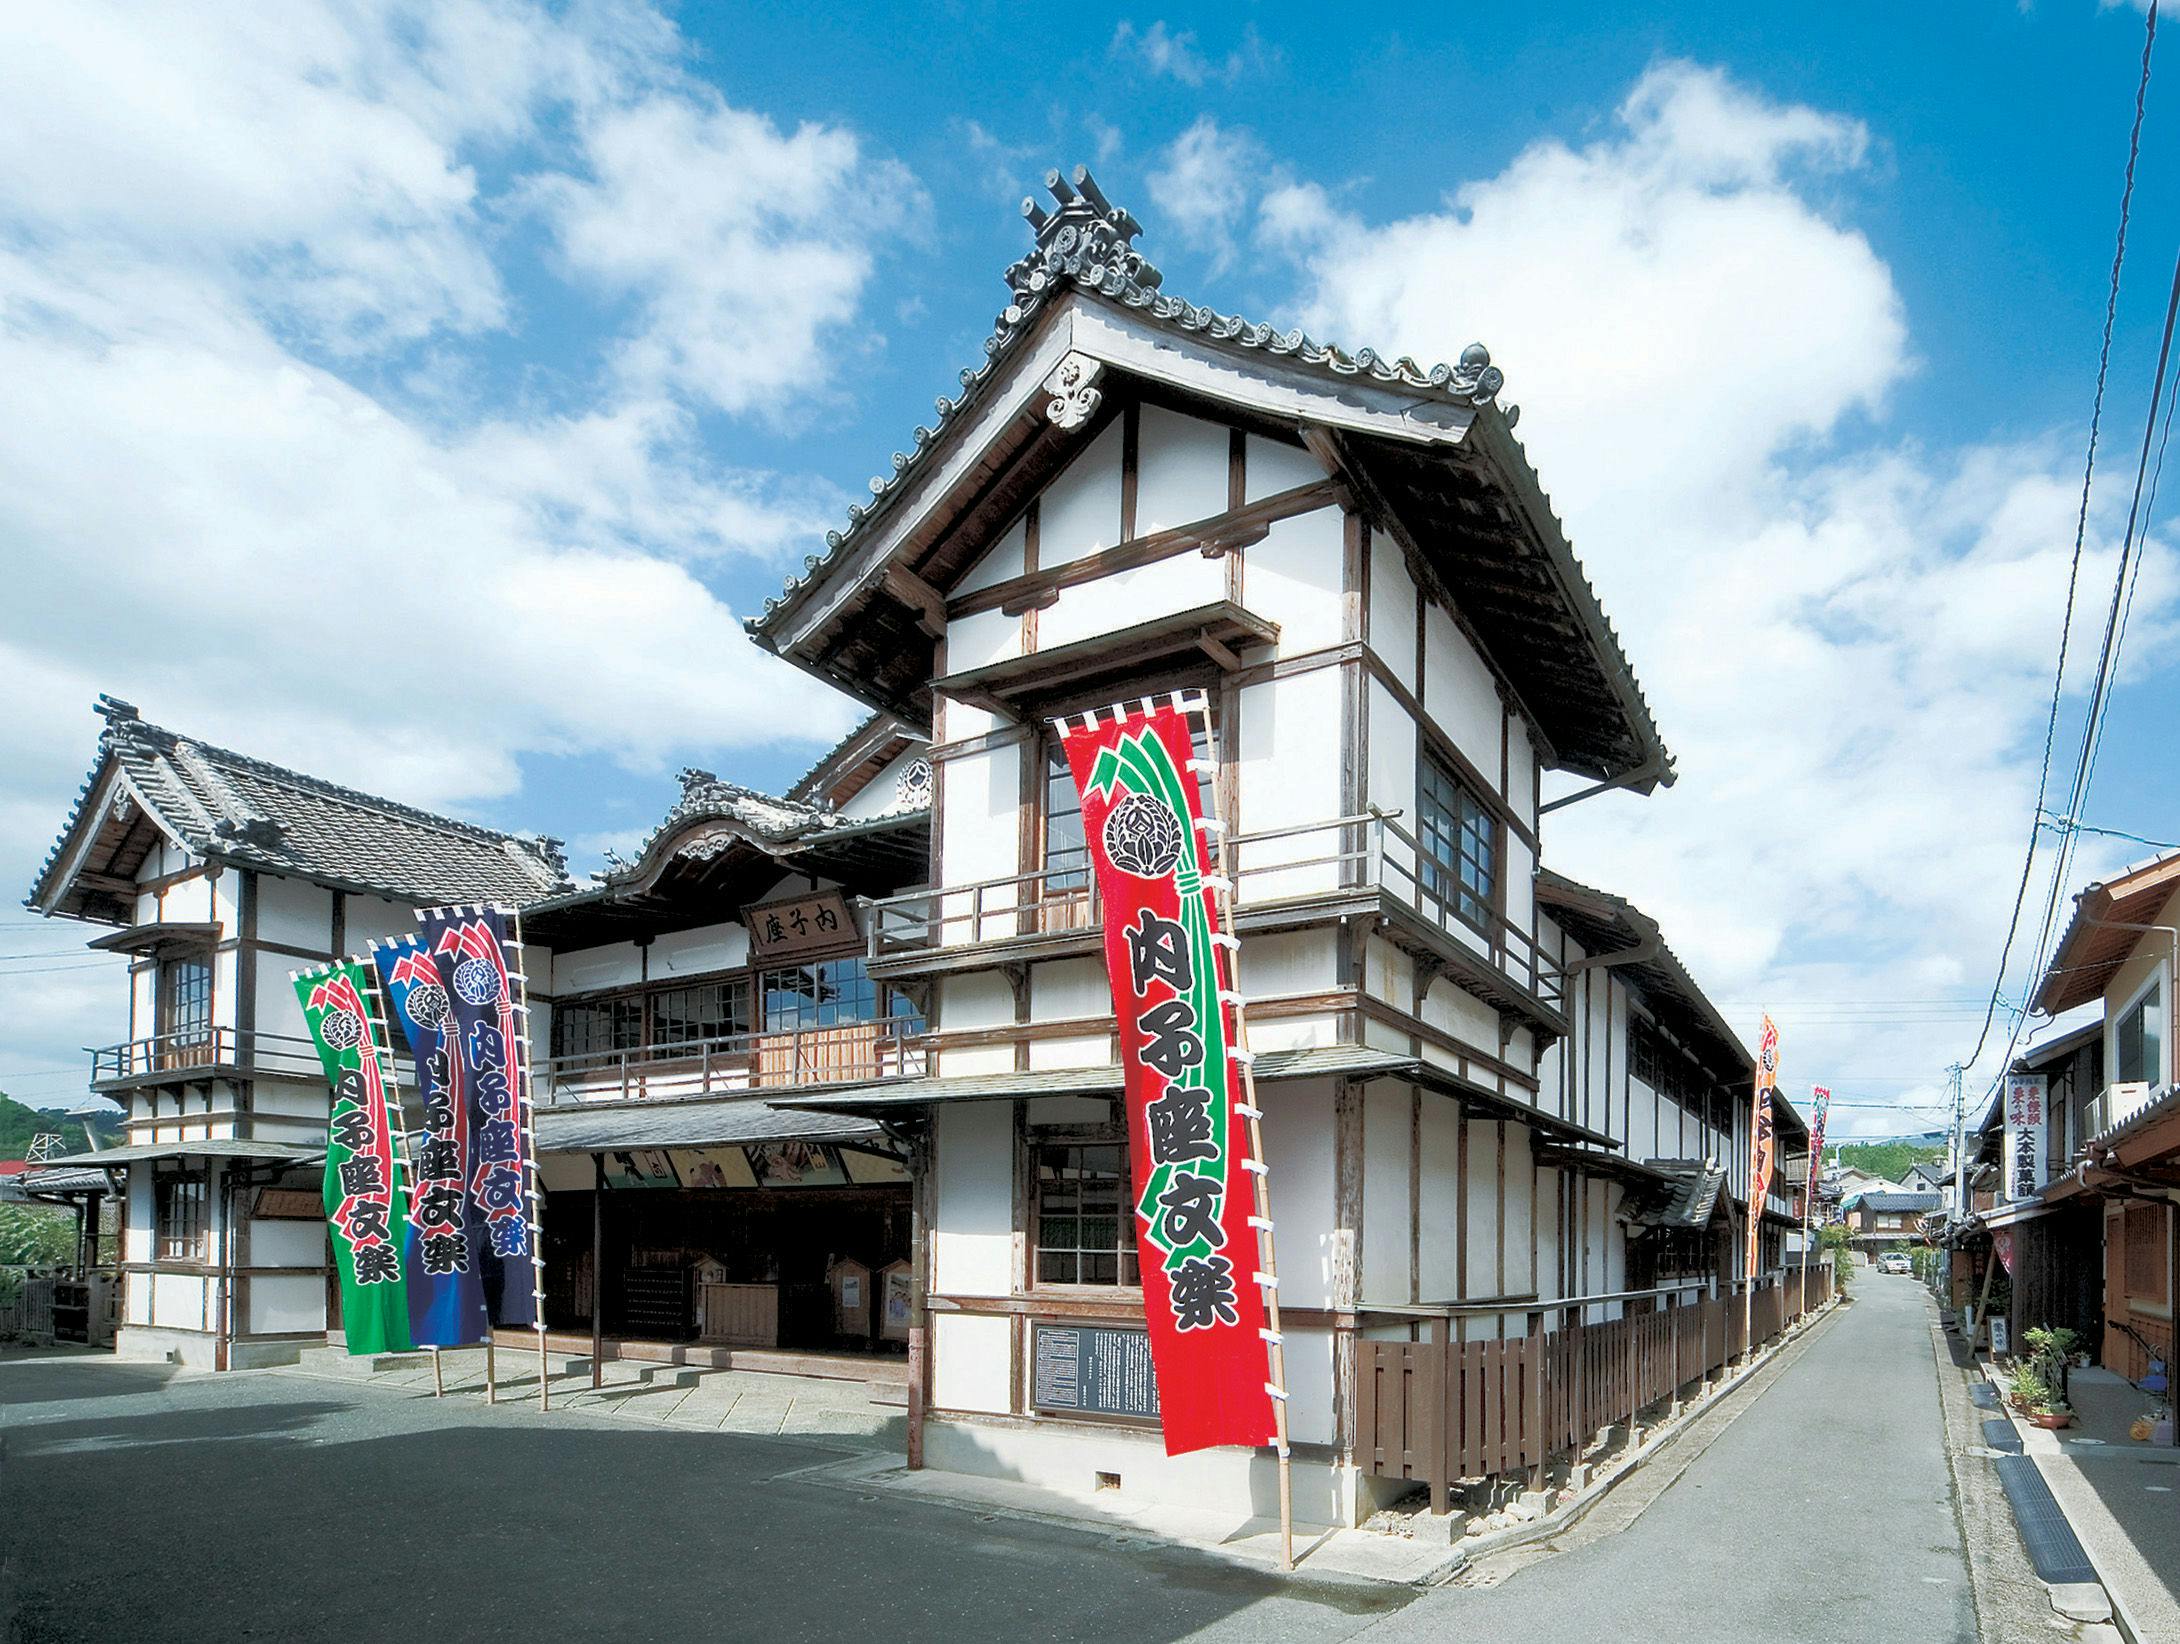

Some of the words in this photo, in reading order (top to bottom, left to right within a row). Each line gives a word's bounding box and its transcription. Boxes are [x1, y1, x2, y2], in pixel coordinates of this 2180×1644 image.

[766, 903, 838, 943] 内子座
[1126, 908, 1240, 1333] 内子座文楽
